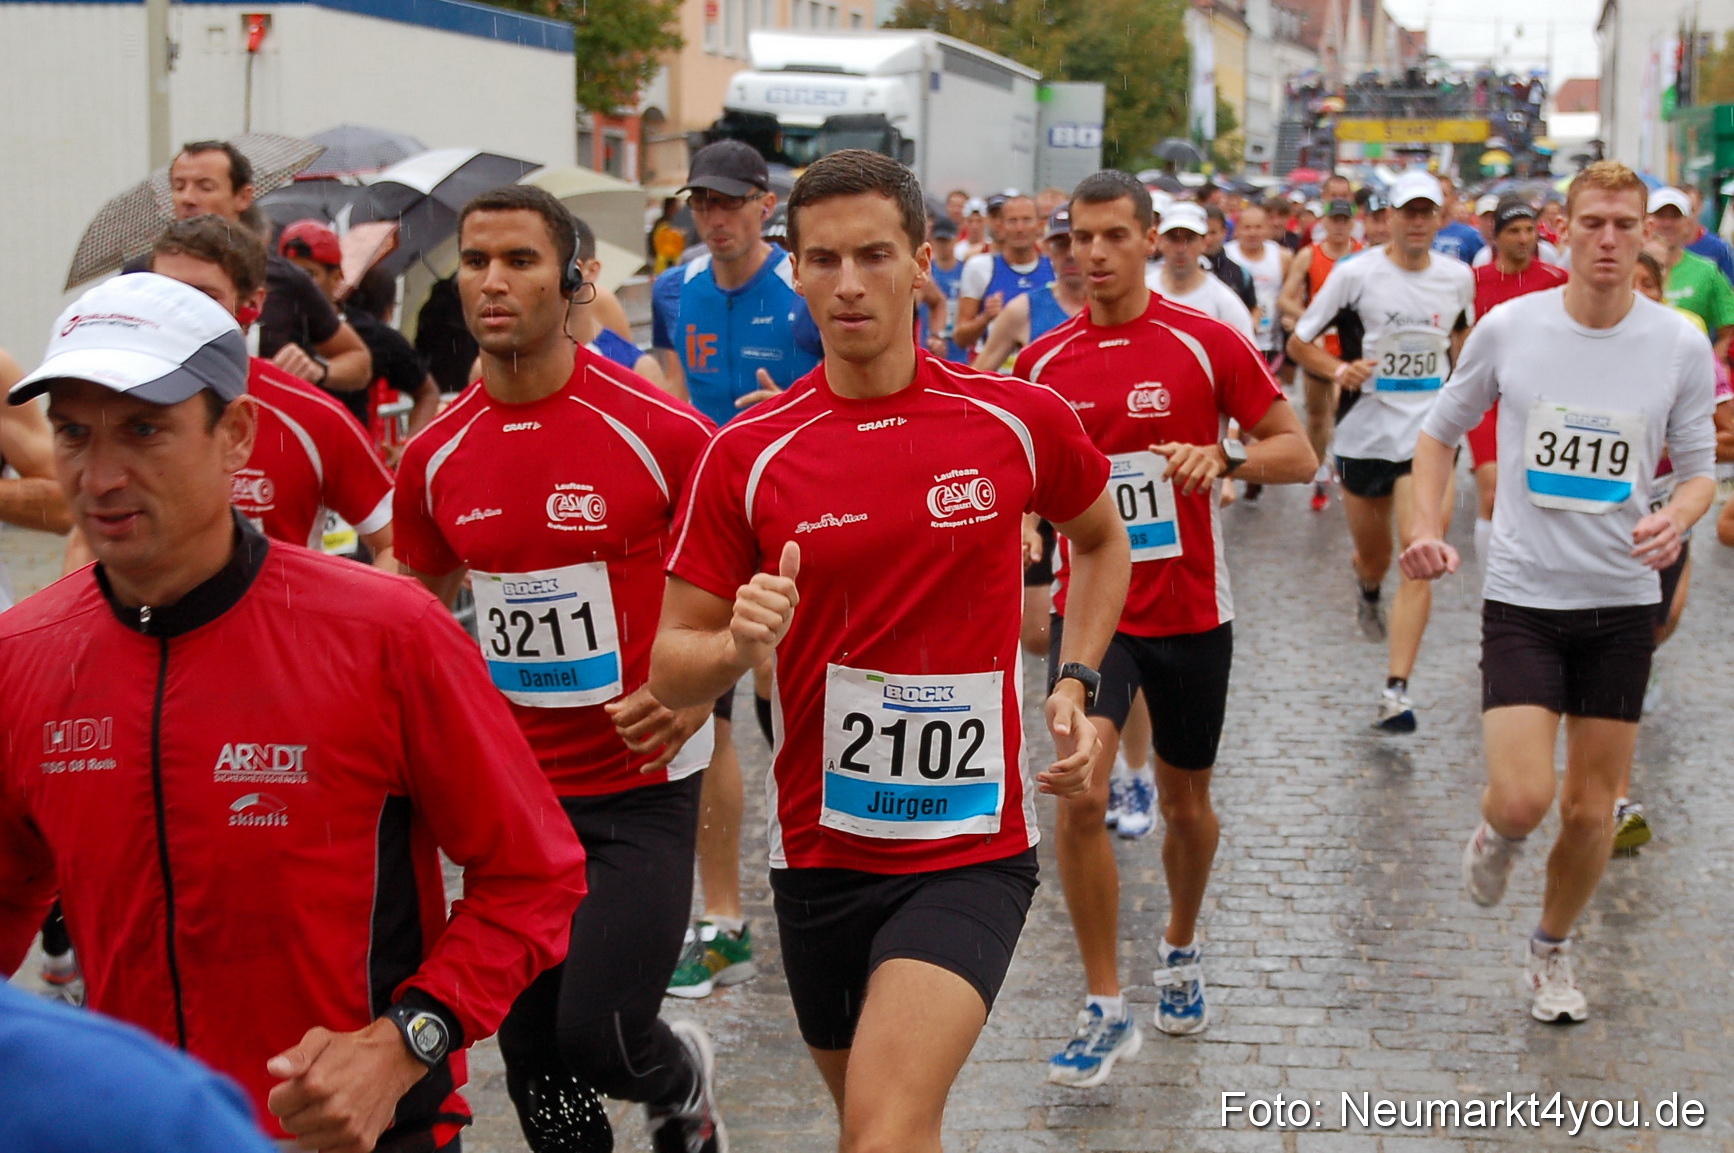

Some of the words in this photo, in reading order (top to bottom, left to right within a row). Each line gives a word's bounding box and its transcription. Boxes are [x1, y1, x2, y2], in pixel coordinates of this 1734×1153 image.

[1382, 352, 1437, 376] 3250
[503, 422, 533, 432] CRAFT
[857, 417, 896, 431] CRAFT
[1535, 431, 1629, 476] 3419
[934, 469, 979, 482] Laufteam
[943, 482, 971, 503] ASV
[1116, 480, 1158, 521] 01
[931, 519, 967, 528] Kraftsport
[1130, 533, 1147, 545] as
[503, 578, 559, 596] BOCK
[488, 601, 598, 657] 3211
[519, 667, 578, 687] Daniel
[883, 684, 955, 702] BOCK
[42, 716, 113, 754] HDI
[839, 712, 986, 780] 2102
[213, 742, 308, 771] ARNDT
[827, 760, 835, 770] A
[867, 791, 948, 821] Jürgen
[228, 812, 289, 827] skinfit
